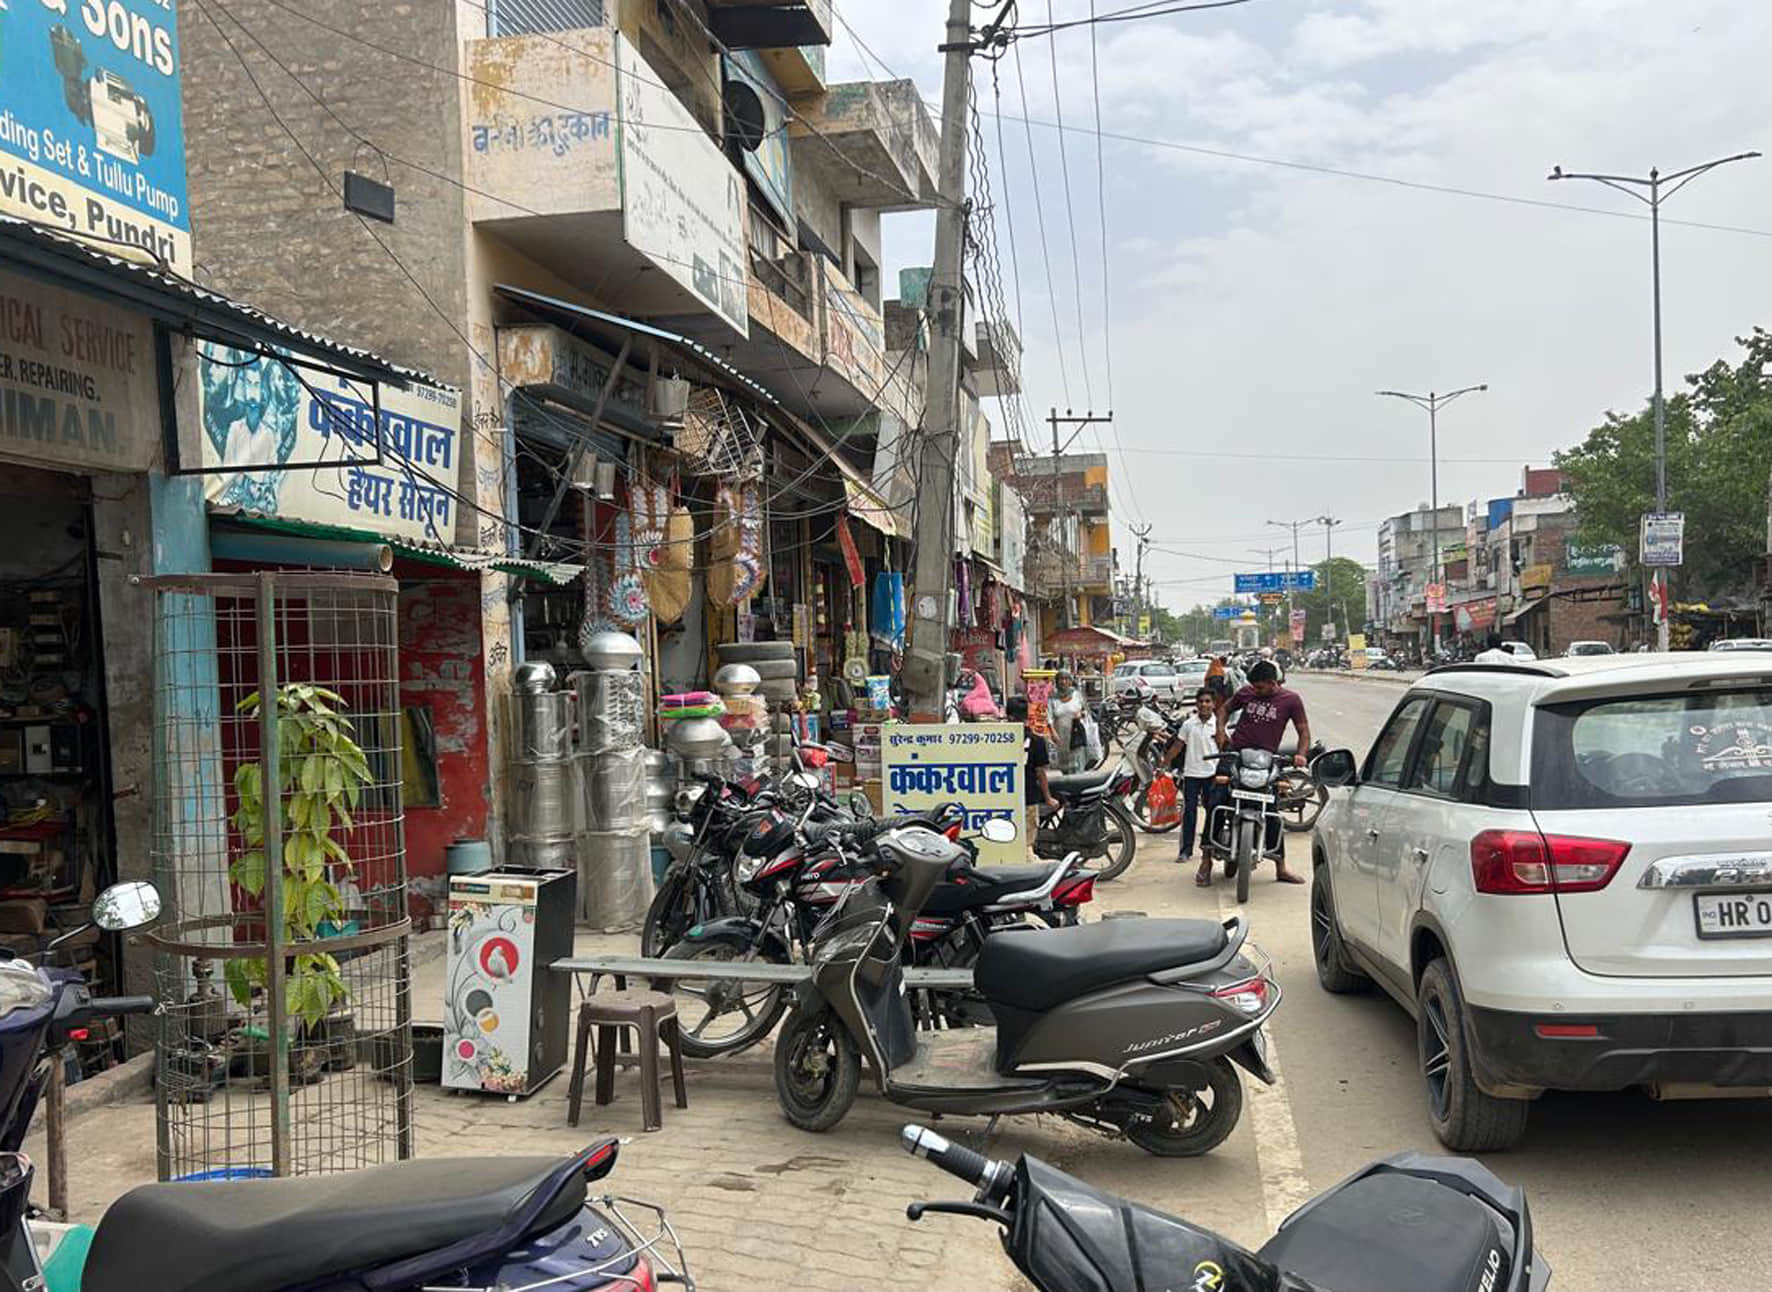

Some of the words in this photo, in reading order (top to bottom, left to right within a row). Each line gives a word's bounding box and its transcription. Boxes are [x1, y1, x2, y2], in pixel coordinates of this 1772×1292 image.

[43, 128, 74, 170] Set
[77, 145, 91, 177] &
[93, 151, 133, 197] Tullu
[136, 172, 179, 222] Pump
[86, 197, 176, 263] Pundri
[61, 313, 137, 375] SERVICE
[949, 732, 1015, 745] 97299-70258
[888, 752, 1017, 794] कंकरवाल
[1718, 902, 1750, 926] HR
[1478, 1248, 1500, 1292] ELIO
